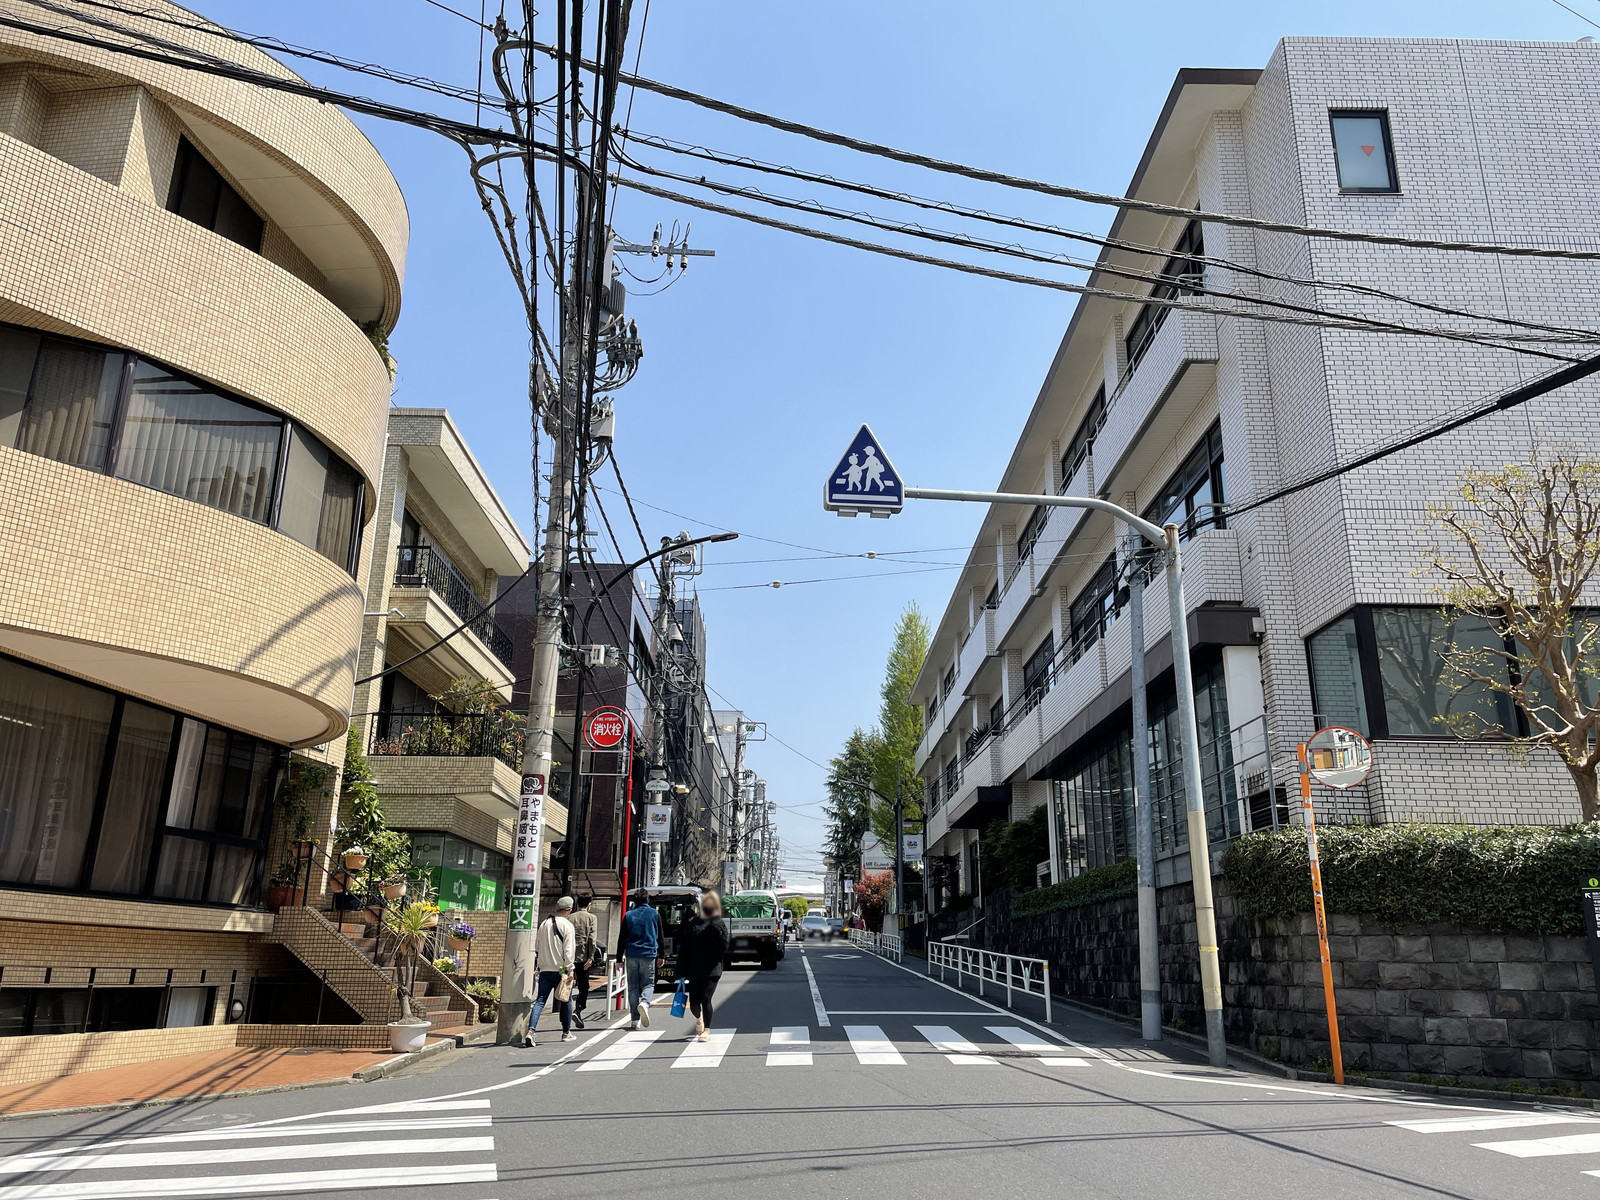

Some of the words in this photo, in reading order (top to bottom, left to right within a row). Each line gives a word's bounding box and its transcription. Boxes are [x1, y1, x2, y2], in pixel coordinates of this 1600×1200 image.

[593, 723, 622, 736] 消火栓
[517, 798, 530, 861] 耳鼻咽喉科
[527, 798, 540, 848] やまもと
[511, 907, 530, 925] 文
